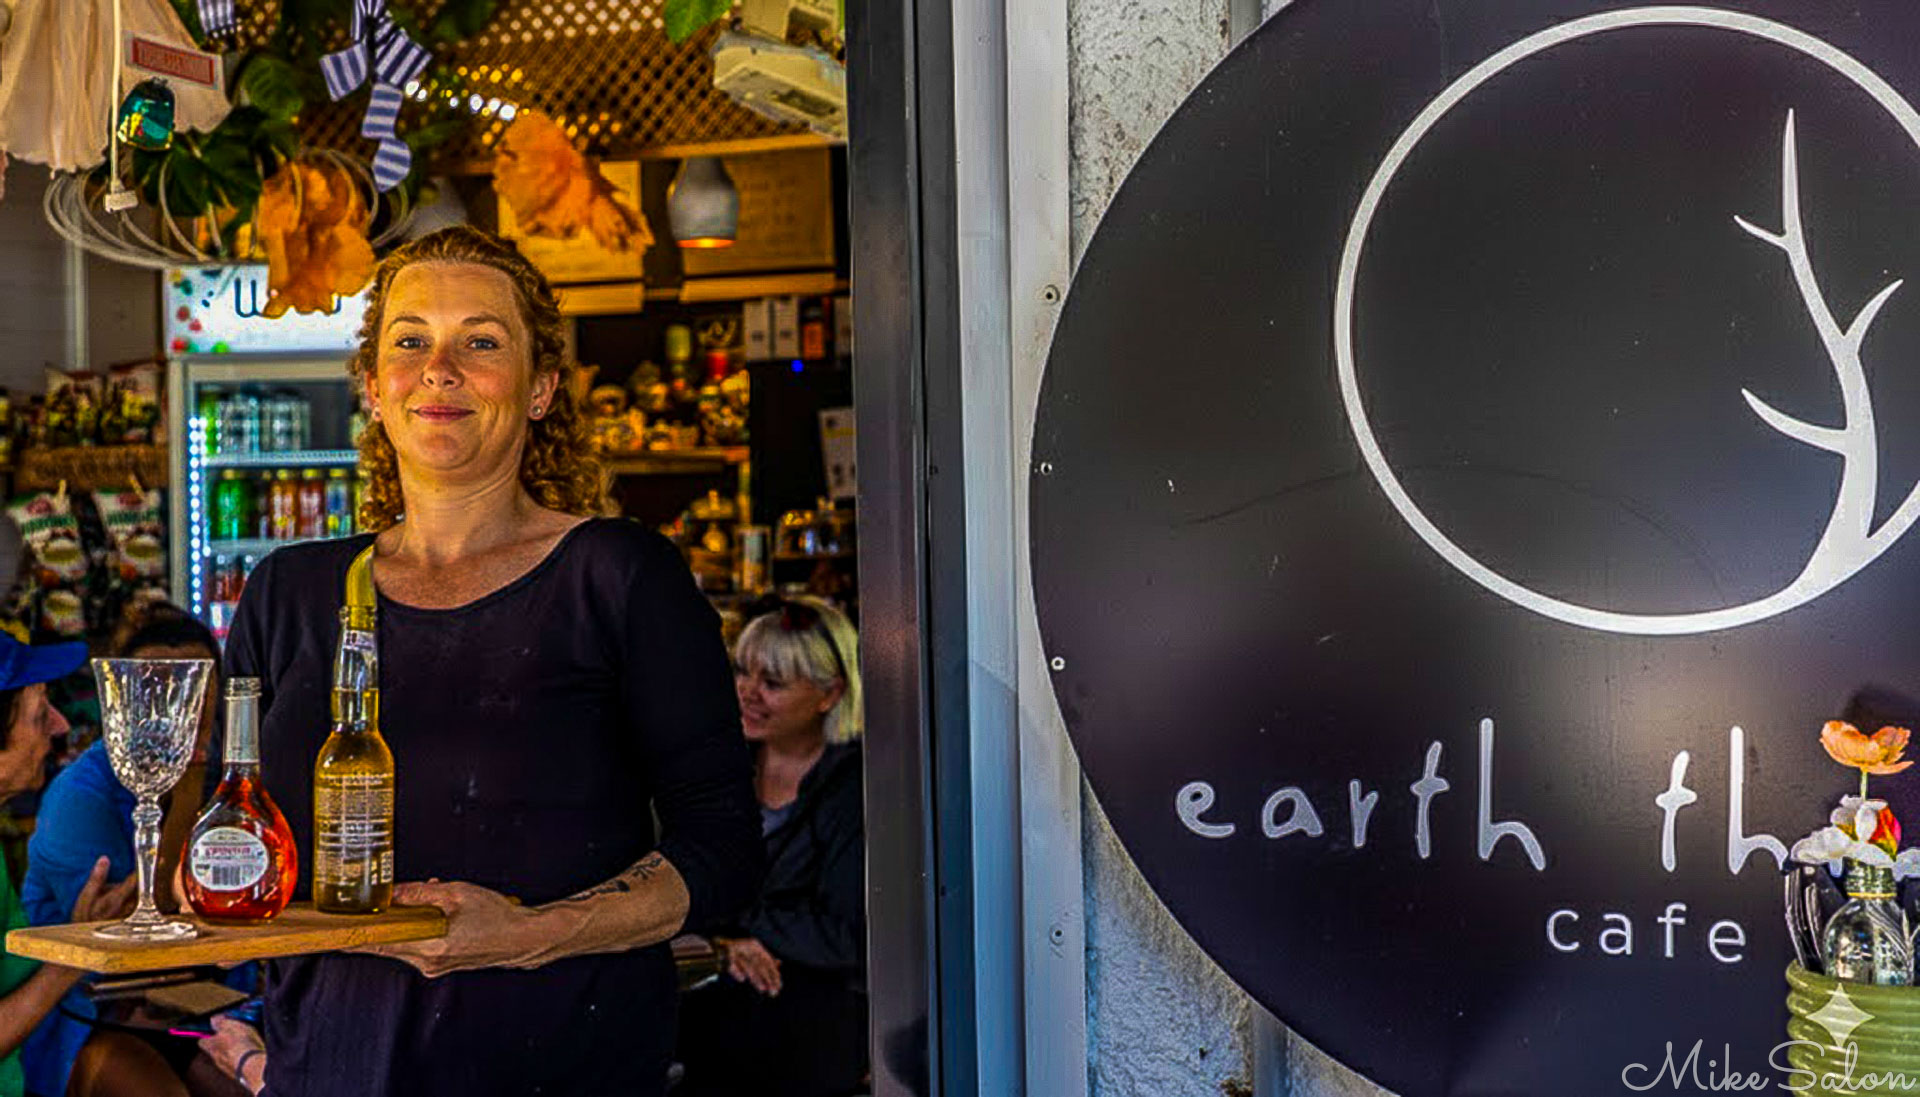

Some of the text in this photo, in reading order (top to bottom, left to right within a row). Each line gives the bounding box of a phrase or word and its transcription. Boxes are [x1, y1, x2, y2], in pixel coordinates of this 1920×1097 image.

[1175, 716, 1844, 879] earth th
[1545, 902, 1747, 964] cafe
